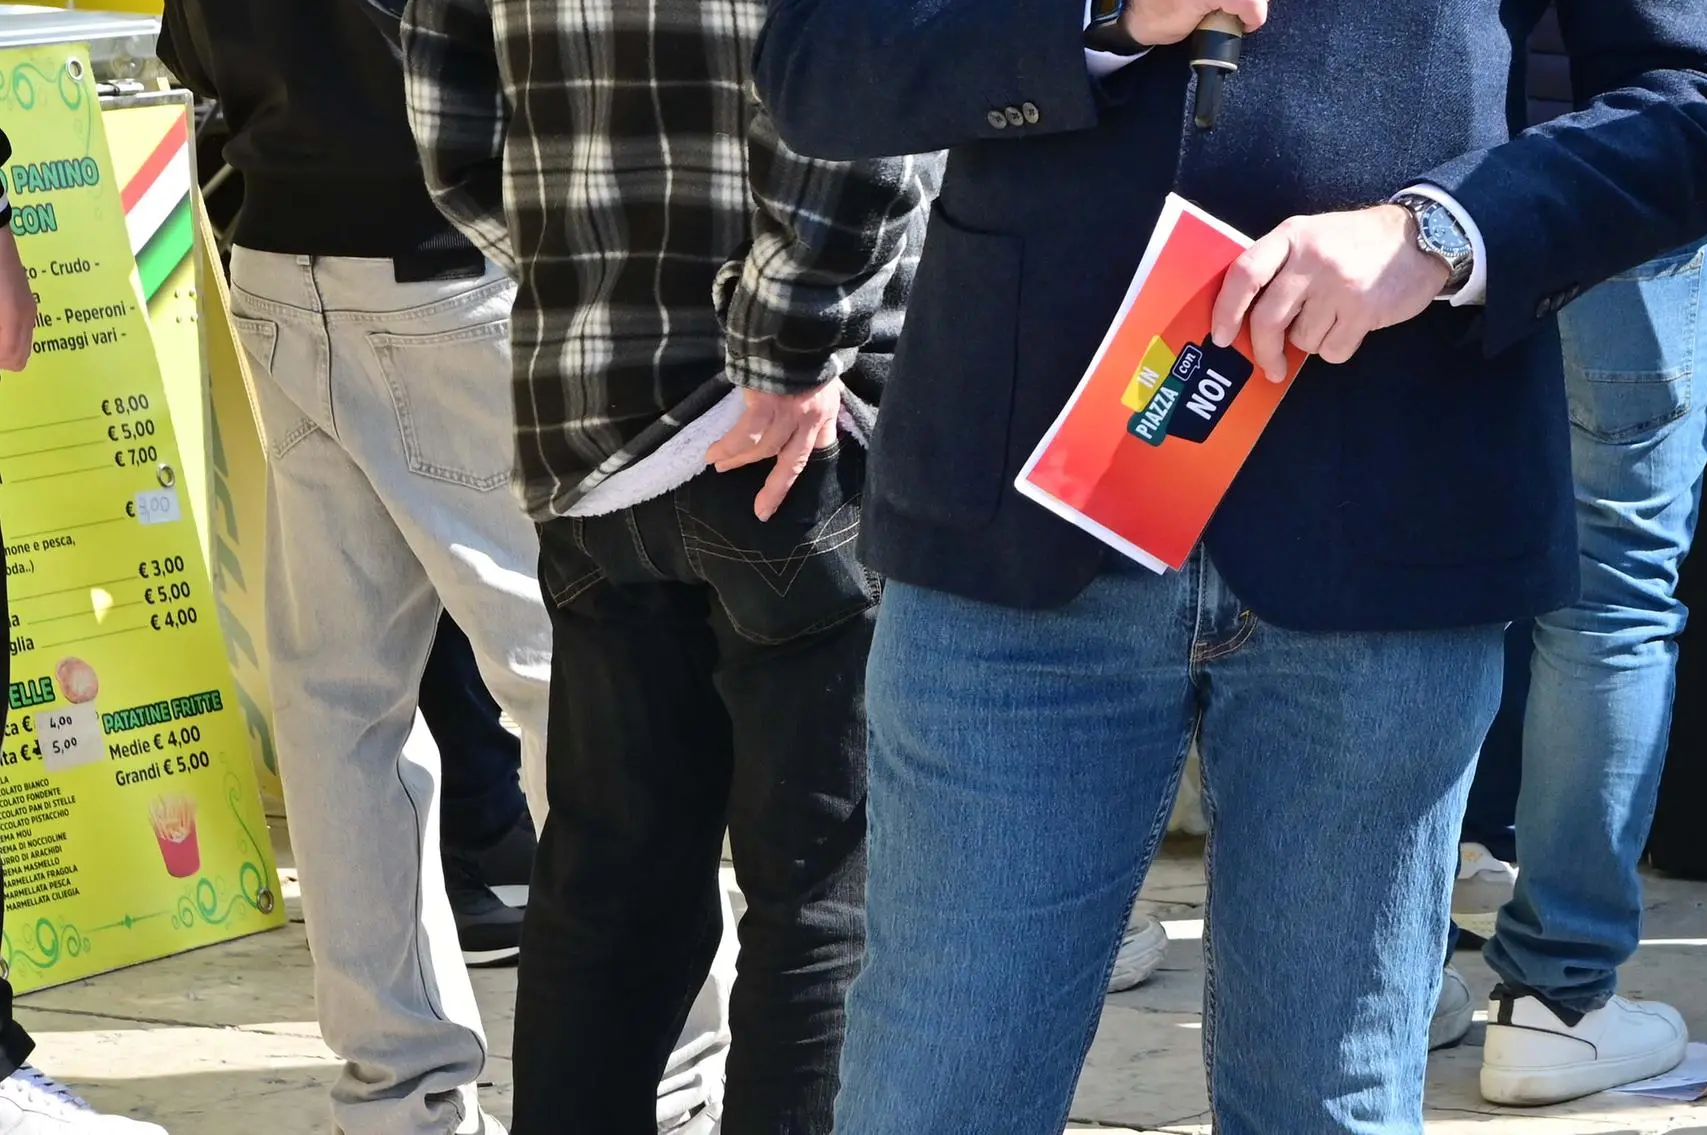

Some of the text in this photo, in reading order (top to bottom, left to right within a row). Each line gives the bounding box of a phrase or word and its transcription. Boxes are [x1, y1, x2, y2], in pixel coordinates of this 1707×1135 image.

[11, 156, 100, 196] PANINO
[11, 202, 58, 237] CON
[50, 257, 91, 277] Crudo
[65, 300, 127, 325] Peperoni
[92, 326, 118, 346] vari
[1178, 350, 1197, 376] con
[1137, 366, 1161, 390] IN
[102, 393, 149, 416] € 8,00
[1186, 367, 1233, 421] NOI
[1135, 387, 1179, 440] PIAZZA
[108, 418, 155, 442] € 5,00
[114, 445, 158, 468] € 7,00
[125, 500, 136, 518] €
[33, 541, 40, 551] e
[42, 535, 76, 551] pesca,
[138, 555, 185, 579] € 3,00
[144, 581, 191, 605] € 5,00
[150, 607, 198, 632] € 4,00
[22, 715, 33, 732] €
[50, 715, 73, 731] 4,00
[102, 689, 224, 735] PATATINE FRITTE
[20, 744, 32, 760] €
[53, 736, 78, 754] 5,00
[109, 725, 201, 760] Medie € 4,00
[115, 751, 210, 787] Grandi € 5,00
[24, 778, 50, 791] BIANCO
[26, 786, 61, 801] FONDENTE
[29, 802, 43, 813] PAN
[44, 801, 52, 810] DI
[53, 794, 76, 808] STELLE
[31, 808, 70, 825] PISTACCHIO
[16, 828, 32, 840] MOU
[19, 841, 27, 850] DI
[27, 831, 68, 848] NOCCIOLINE
[21, 852, 30, 862] DI
[31, 844, 63, 859] ARACHIDI
[23, 856, 60, 872] MASMELLO
[46, 864, 79, 879] FRAGOLA
[49, 877, 72, 890] PESCA
[6, 886, 81, 912] MARMELLATA CILIEGIA
